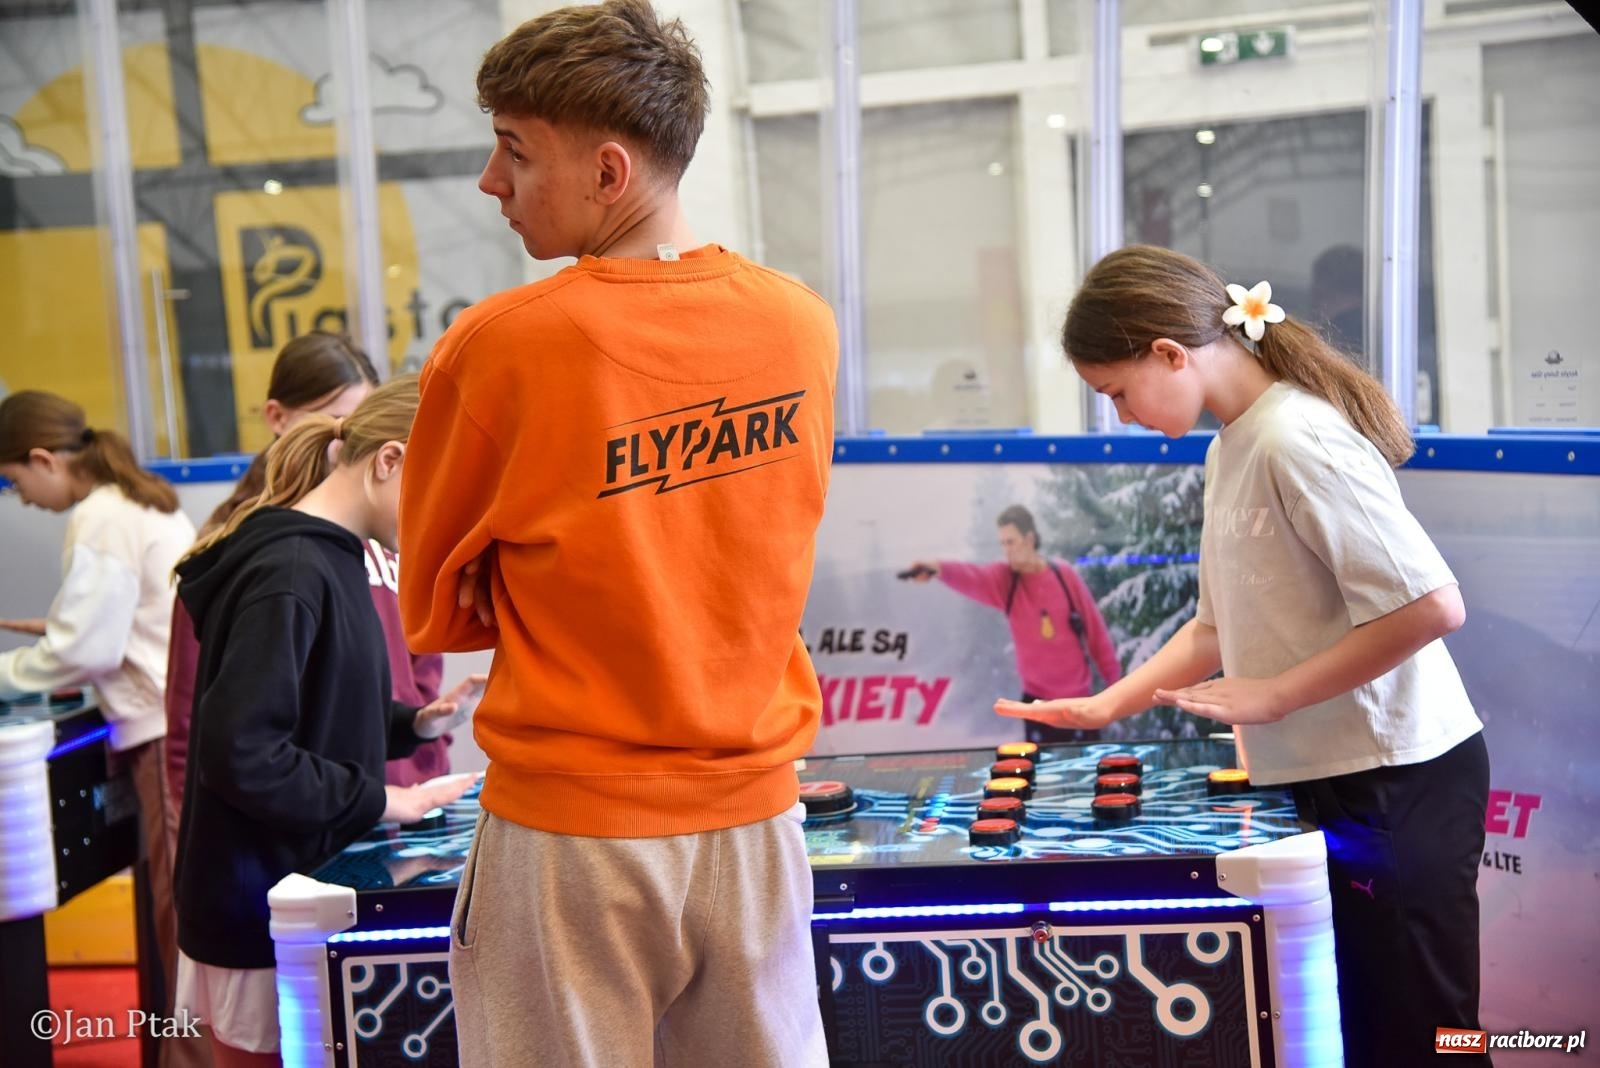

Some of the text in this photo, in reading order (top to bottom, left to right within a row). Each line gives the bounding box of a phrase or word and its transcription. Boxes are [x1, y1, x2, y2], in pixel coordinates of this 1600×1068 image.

[606, 402, 801, 484] FLYPARK
[819, 628, 908, 660] ALE SĄ
[1495, 851, 1522, 874] LTE
